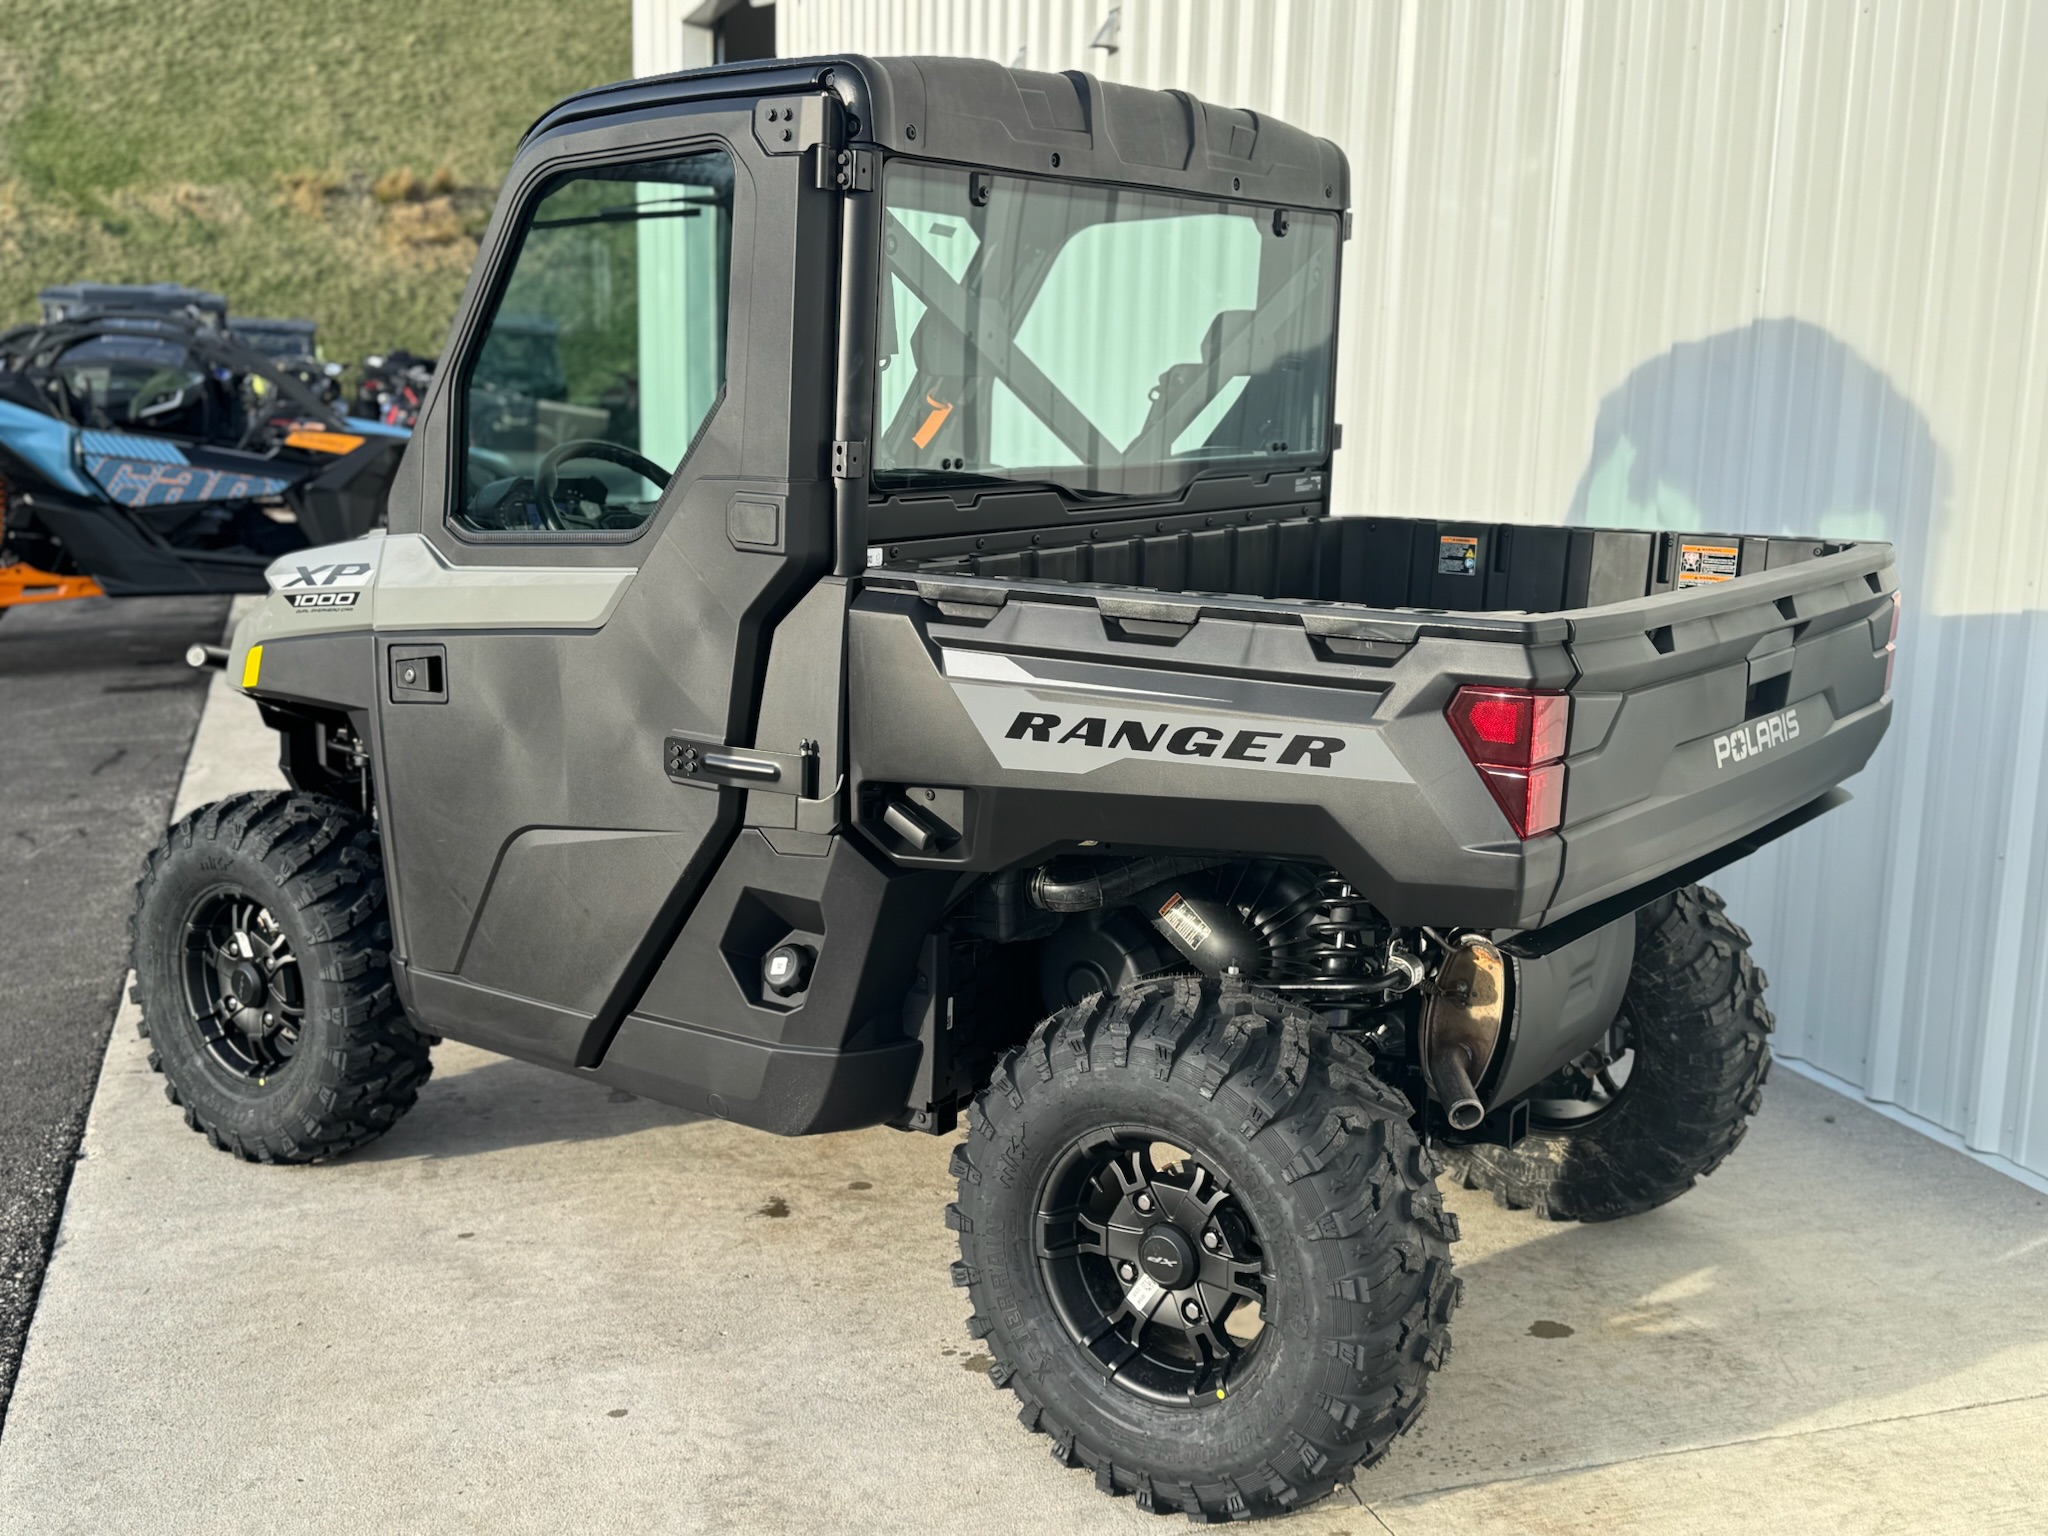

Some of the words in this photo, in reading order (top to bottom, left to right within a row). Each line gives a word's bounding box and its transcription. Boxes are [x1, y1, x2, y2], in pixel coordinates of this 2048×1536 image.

[281, 563, 371, 588] XP
[294, 593, 355, 606] 1000
[1004, 711, 1346, 769] RANGER
[1713, 709, 1800, 769] POLARIS
